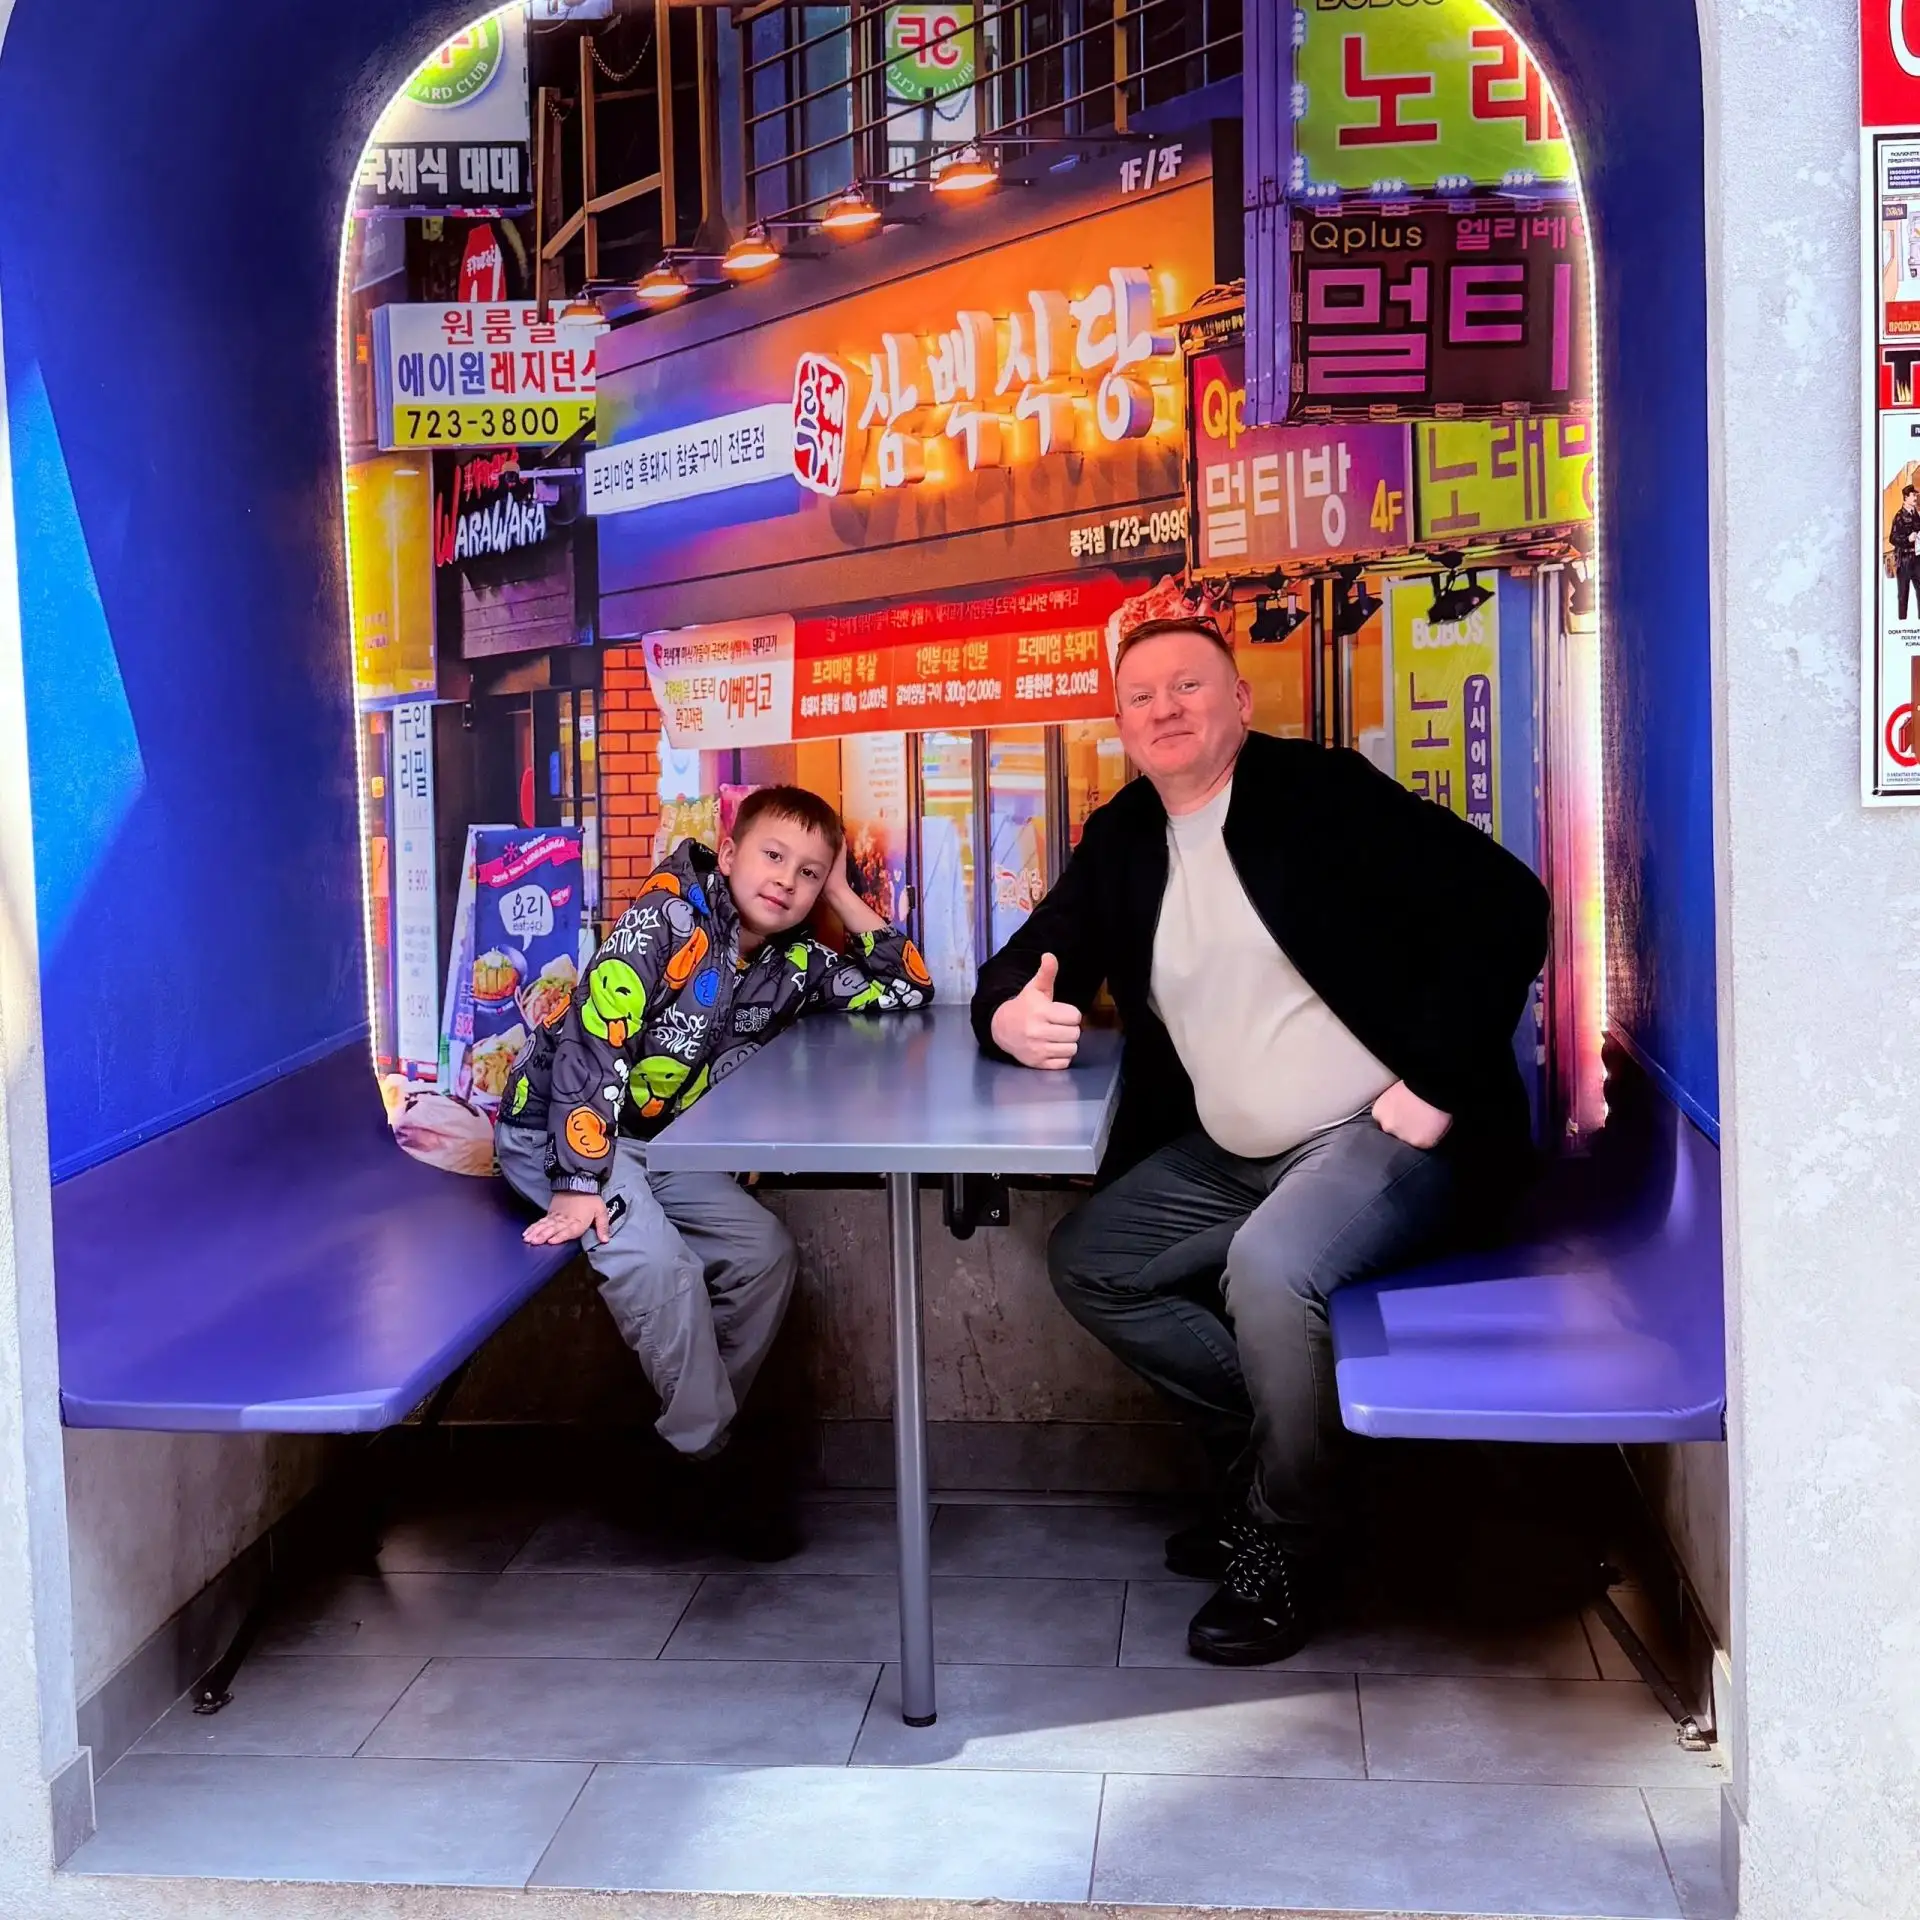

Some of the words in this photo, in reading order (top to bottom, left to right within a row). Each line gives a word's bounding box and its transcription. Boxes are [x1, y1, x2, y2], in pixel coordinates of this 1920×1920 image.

[456, 60, 489, 94] CLUB
[359, 147, 449, 195] 국제식
[458, 147, 520, 194] 대대
[1119, 143, 1183, 194] 1F/2F
[1309, 221, 1424, 254] Qplus
[440, 308, 557, 346] 원룸텔
[1307, 263, 1572, 395] 멀티
[857, 266, 1160, 490] 삼백식당
[406, 406, 560, 440] 723-3800
[593, 458, 635, 496] 프리미엄
[638, 449, 673, 486] 흑돼지
[675, 434, 724, 478] 참숯구이
[727, 424, 766, 465] 전문점
[1205, 442, 1352, 560] 멀티방
[1369, 479, 1403, 535] 4F
[1109, 506, 1188, 551] 723-0999
[812, 655, 852, 685] 프리미엄
[1016, 633, 1062, 666] 프리미엄
[1063, 630, 1098, 662] 흑돼지
[719, 673, 772, 721] 이베리코
[1055, 667, 1099, 697] 32,000원
